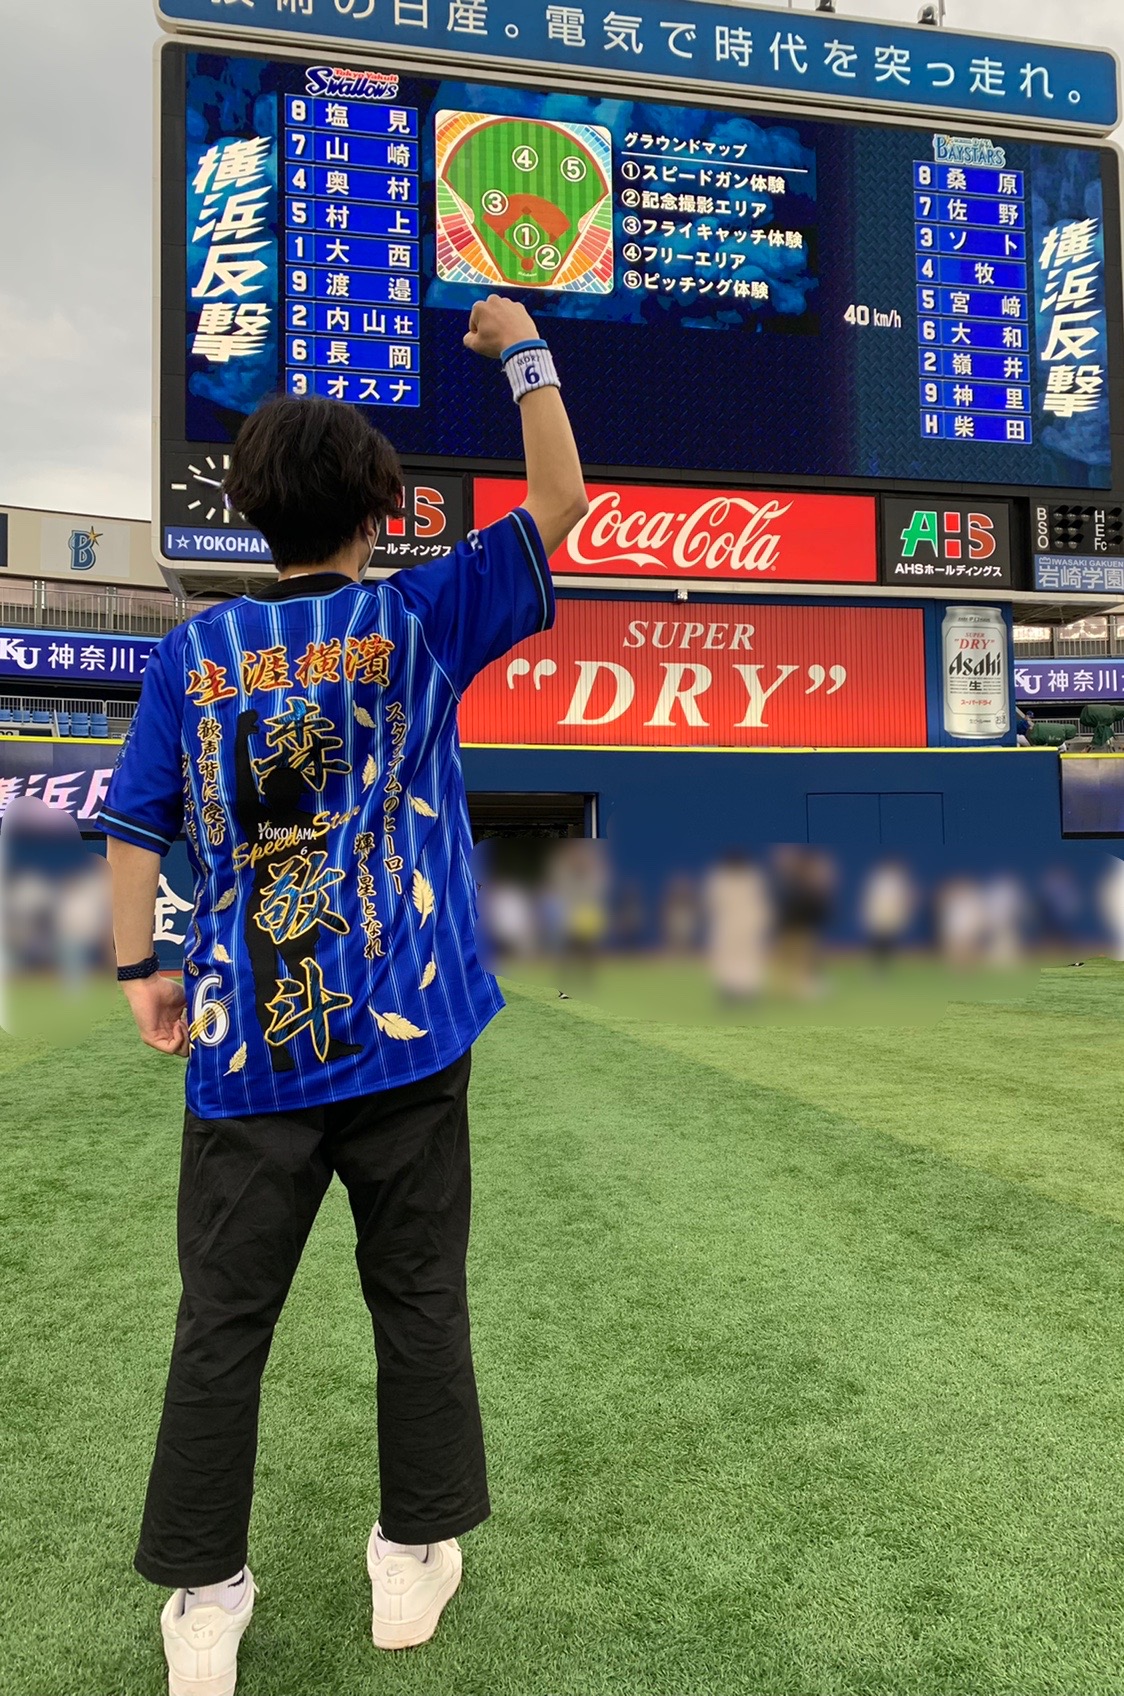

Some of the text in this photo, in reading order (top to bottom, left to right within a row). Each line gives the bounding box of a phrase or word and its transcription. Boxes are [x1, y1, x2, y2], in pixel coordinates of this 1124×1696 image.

[210, 0, 1082, 104] の日産。電気で時代を突っ走れ。
[305, 66, 399, 99] Swallows
[334, 68, 399, 83] Tokyo Yakult
[292, 100, 306, 121] 8
[292, 134, 306, 155] 7
[624, 132, 747, 159] グラウンドマップ
[935, 136, 1005, 166] BAYSTARS
[292, 168, 306, 189] 4
[919, 166, 931, 185] 8
[292, 202, 306, 223] 5
[920, 197, 931, 216] 7
[295, 236, 304, 257] 1
[920, 228, 933, 247] 3
[191, 136, 273, 362] 横浜反撃
[922, 259, 934, 278] 4
[292, 270, 307, 292] 9
[922, 290, 934, 309] 5
[292, 304, 307, 326] 2
[843, 304, 902, 328] 40 km/h
[1039, 218, 1104, 418] 横浜反撃
[923, 321, 935, 340] 6
[292, 339, 307, 361] 6
[924, 352, 937, 371] 2
[292, 373, 307, 395] 3
[525, 365, 540, 384] 6
[925, 383, 937, 402] 9
[925, 414, 938, 434] H
[1036, 507, 1047, 521] B
[1094, 510, 1105, 523] H
[566, 491, 795, 572] Coca-Cola
[900, 510, 996, 559] AHS
[1038, 521, 1048, 535] S
[1095, 524, 1106, 537] E
[193, 535, 269, 553] YOKOHA
[375, 543, 452, 557] ールディングス
[1037, 535, 1049, 549] O
[895, 563, 1002, 577] AHSホールディングス
[1051, 559, 1124, 568] IWASAKI GAKUEN
[1038, 565, 1124, 589] 岩崎学園
[622, 620, 755, 650] SUPER
[185, 633, 395, 706] 生涯横濱
[949, 651, 1001, 677] Asahi
[969, 681, 982, 691] 生
[1048, 669, 1124, 692] 神奈川
[196, 717, 226, 845] 歓声背に受け
[232, 805, 361, 871] Speed Star
[300, 846, 308, 855] 6
[353, 831, 386, 960] 輝く星となれ
[193, 974, 230, 1046] 6
